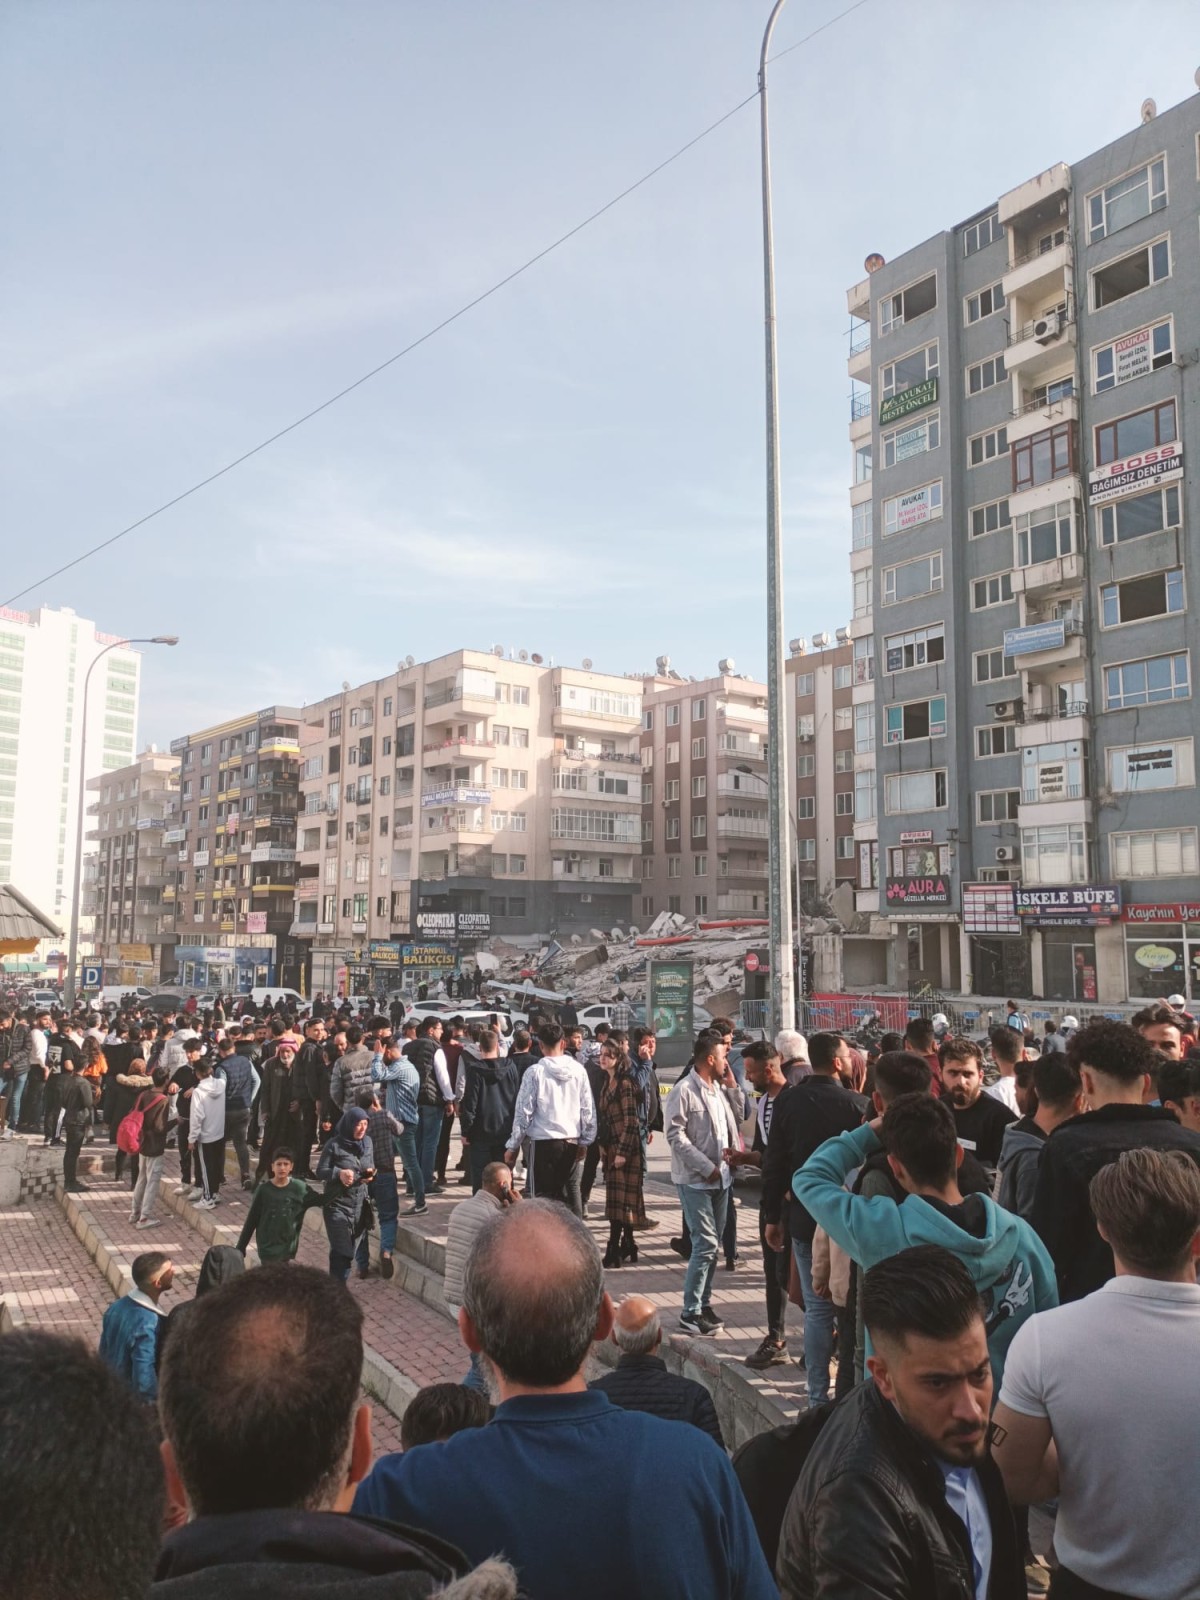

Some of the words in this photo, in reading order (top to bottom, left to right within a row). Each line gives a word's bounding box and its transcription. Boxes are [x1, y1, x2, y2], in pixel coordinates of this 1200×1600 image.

[1116, 332, 1149, 352] AVUKAT
[899, 380, 933, 403] AVUKAT
[882, 405, 905, 422] BESTE
[1111, 446, 1175, 475] BOSS
[1092, 472, 1135, 494] BAĞIMSIZ
[1137, 457, 1180, 479] DENETİM
[901, 491, 925, 506] AVUKAT
[908, 879, 945, 894] AURA
[1016, 890, 1069, 905] İSKELE
[1072, 887, 1115, 904] BÜFE
[423, 913, 455, 928] CLEOPATRA
[459, 914, 490, 924] CLEOPATRA
[1127, 906, 1175, 922] Kaya'nın
[403, 954, 455, 966] BALIKÇISI
